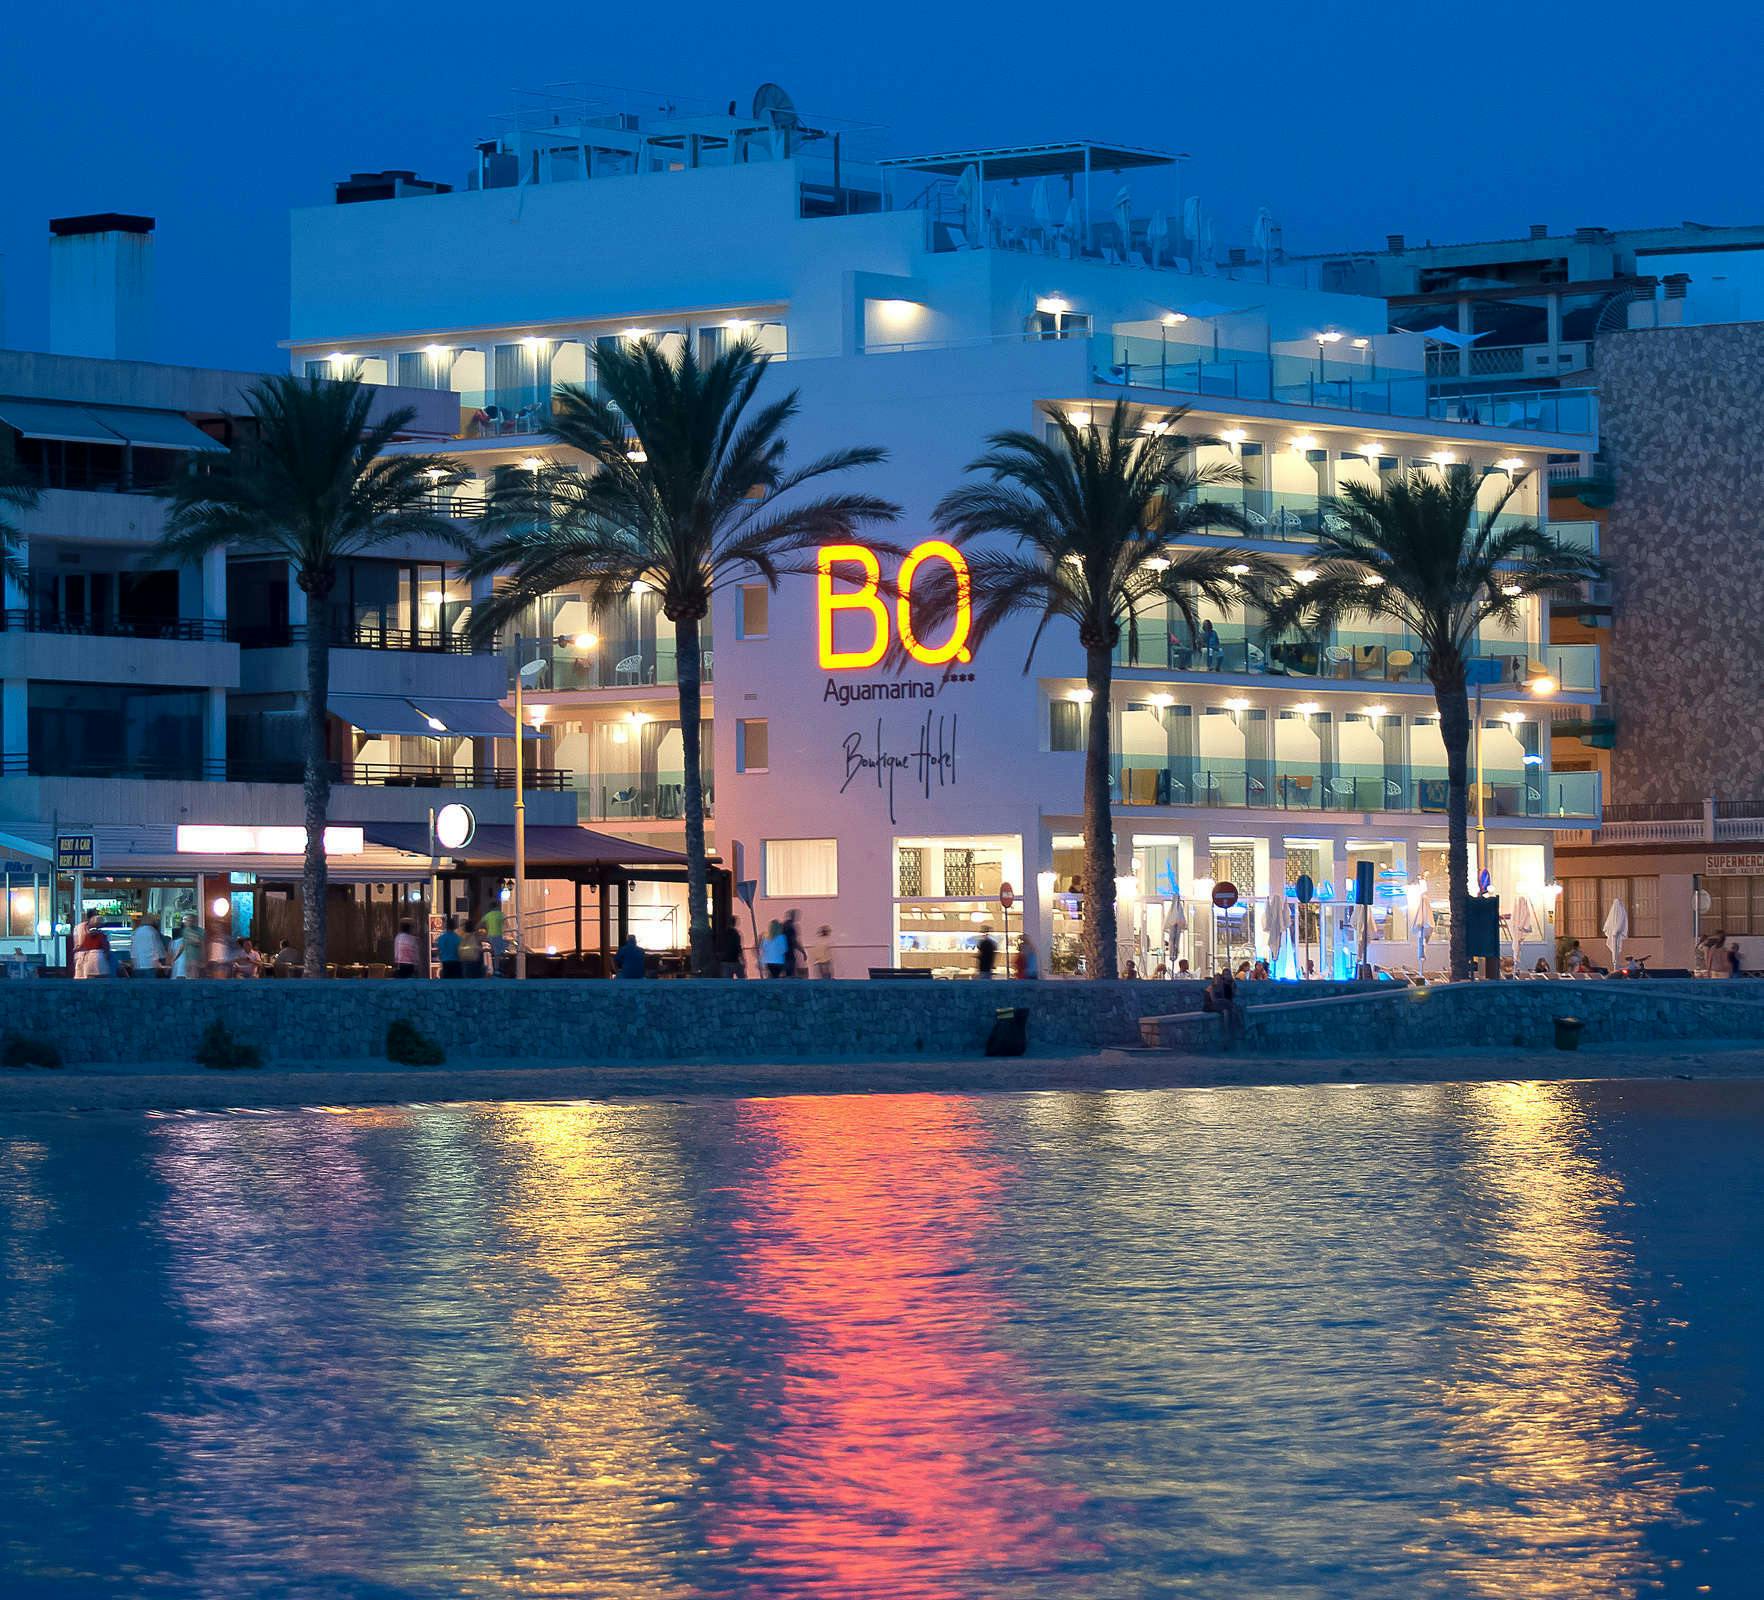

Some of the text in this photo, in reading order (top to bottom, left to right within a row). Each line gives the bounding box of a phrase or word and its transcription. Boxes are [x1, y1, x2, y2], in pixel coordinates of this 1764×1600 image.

[817, 540, 972, 669] BQ
[823, 678, 935, 706] Aguamarina
[840, 709, 957, 825] Boutique Hotel
[75, 839, 79, 850] A
[74, 855, 78, 866] A
[1707, 855, 1764, 867] SUPERMERC
